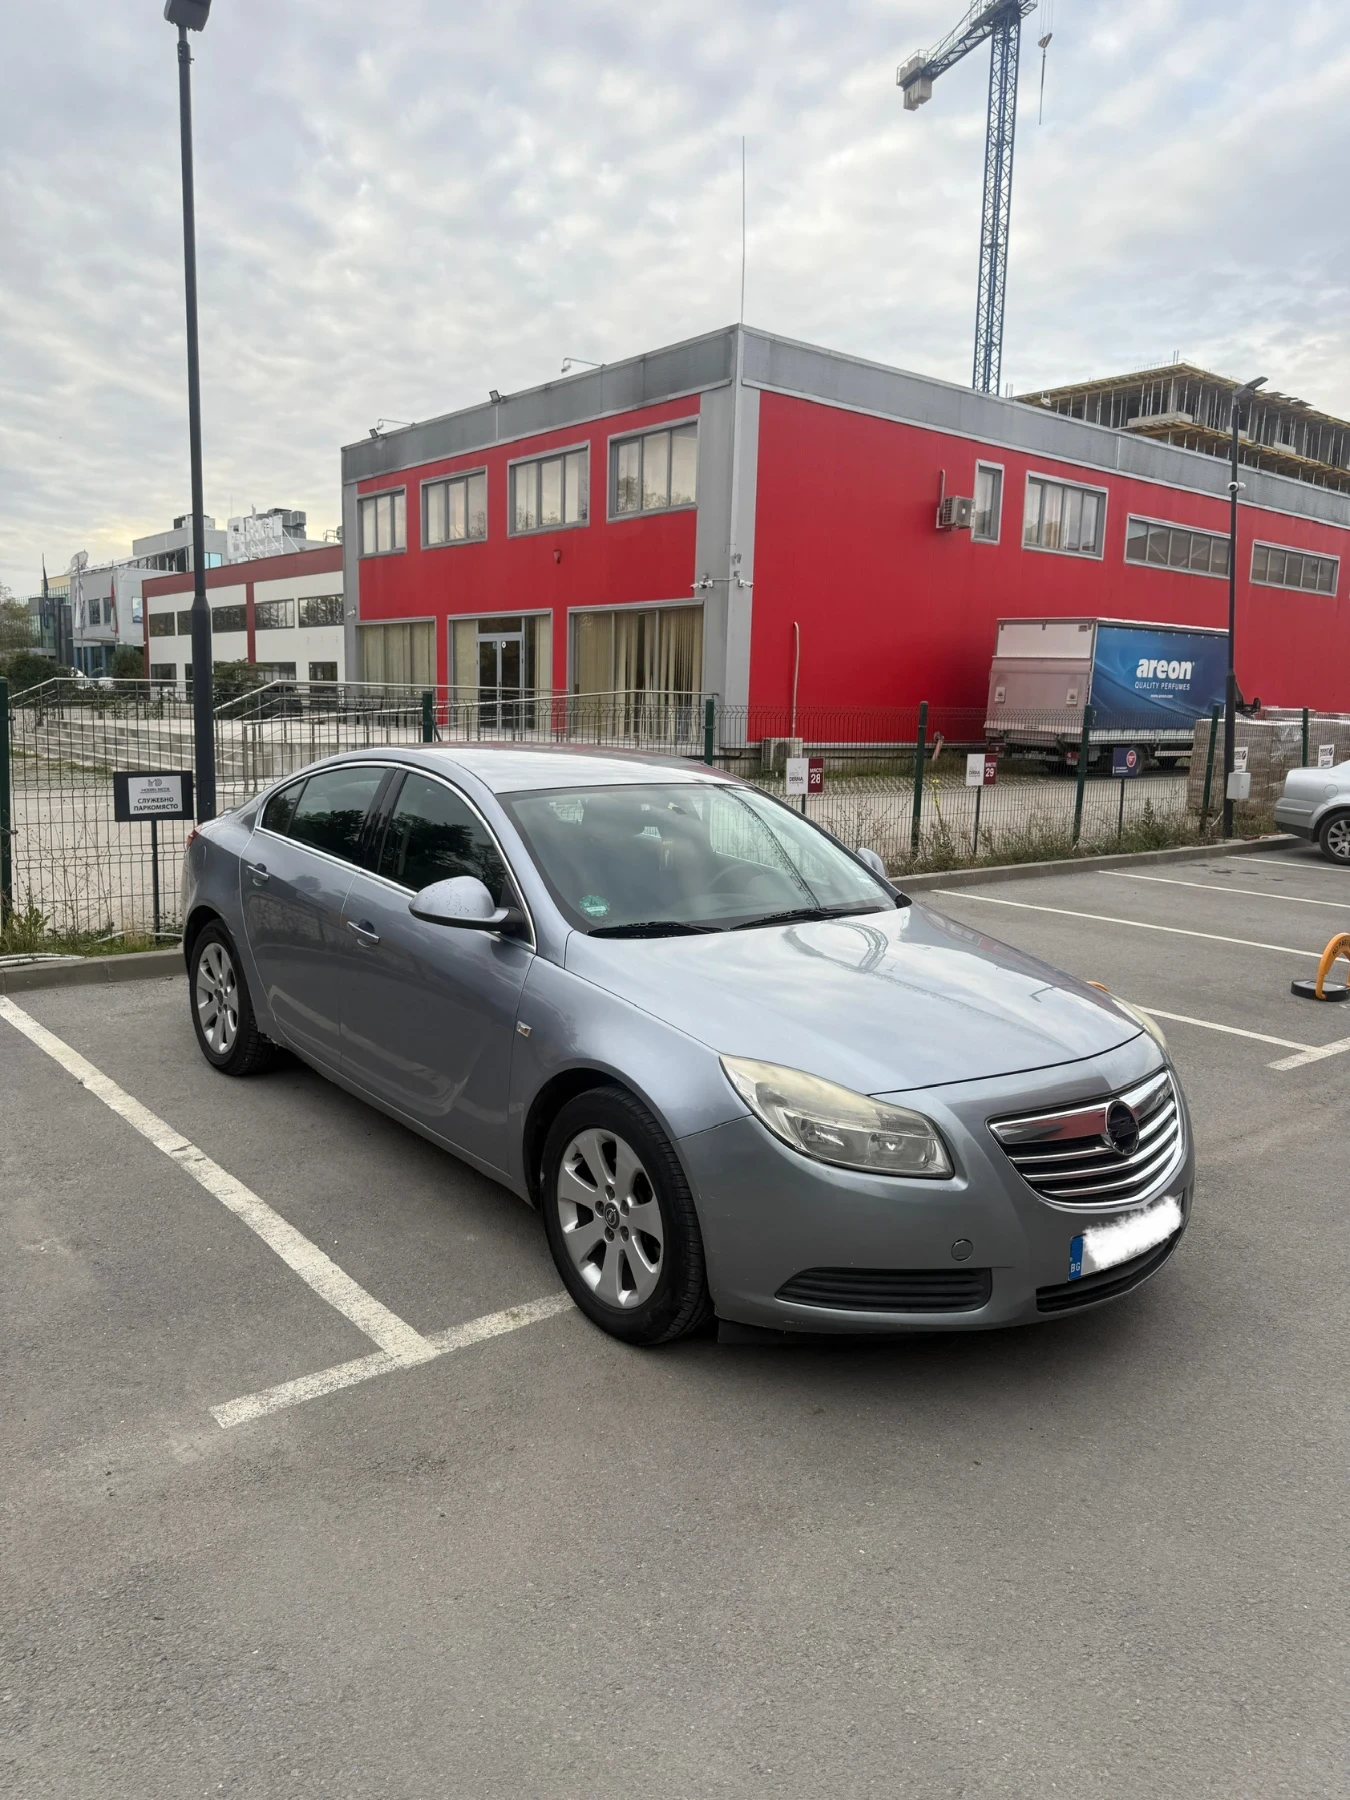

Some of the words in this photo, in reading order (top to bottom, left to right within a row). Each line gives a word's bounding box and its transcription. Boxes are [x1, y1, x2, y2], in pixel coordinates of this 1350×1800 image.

[1136, 658, 1192, 680] areon
[1134, 681, 1159, 689] QUALITY
[1161, 682, 1190, 691] PERFUMES
[985, 768, 995, 777] 29
[810, 773, 821, 784] 28
[137, 796, 174, 804] СЛУЖЕБНО
[133, 803, 179, 812] ПАРКОМЯСТО
[1070, 1261, 1081, 1273] BG
